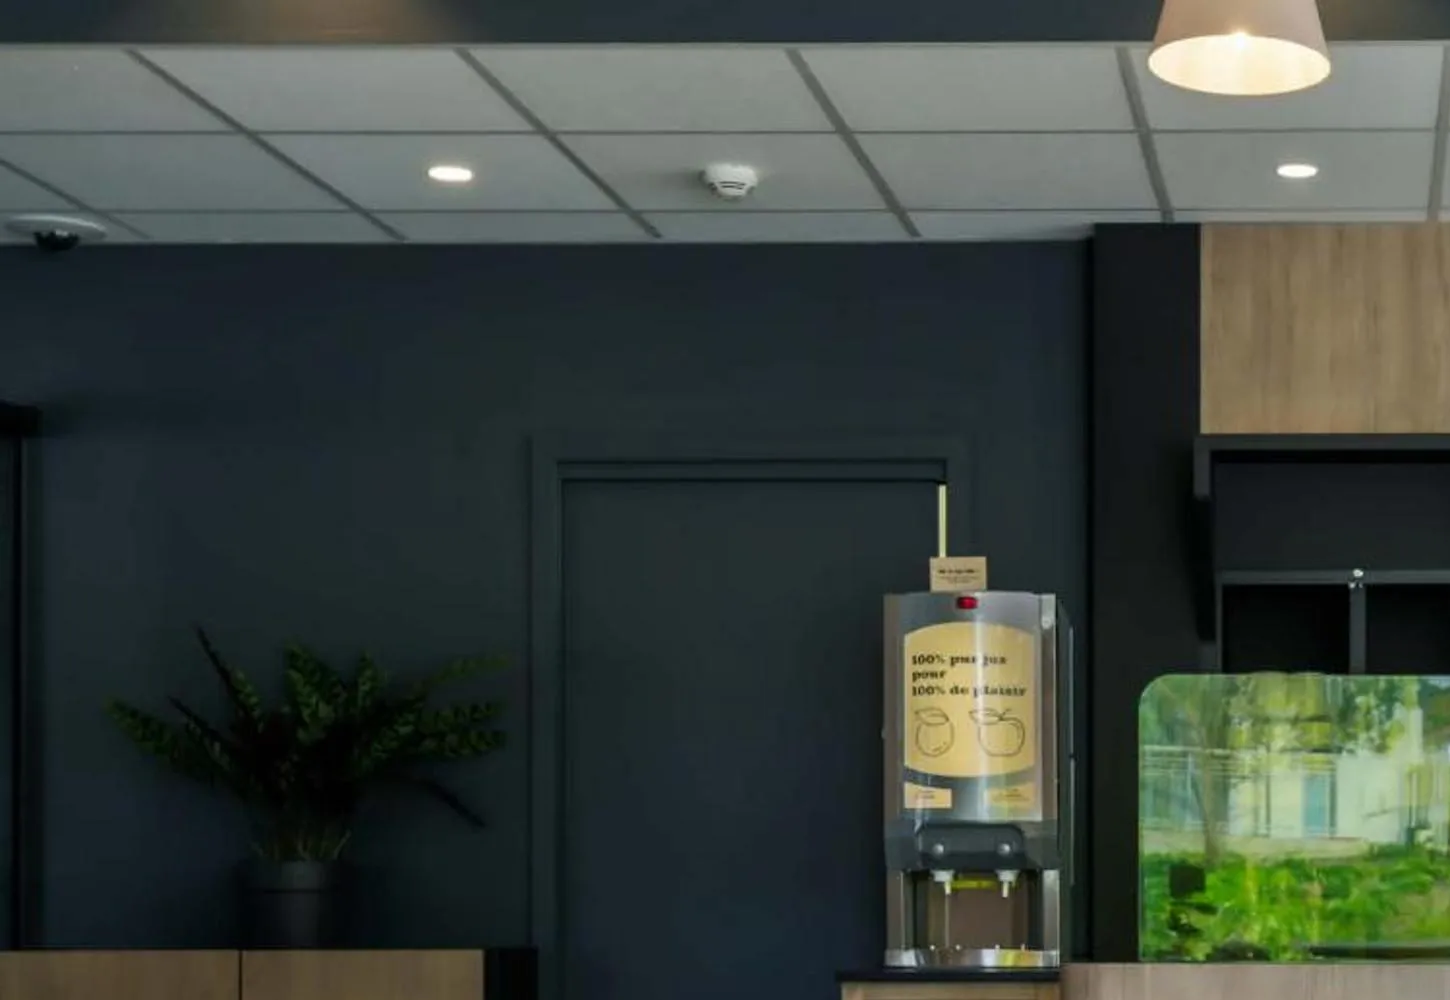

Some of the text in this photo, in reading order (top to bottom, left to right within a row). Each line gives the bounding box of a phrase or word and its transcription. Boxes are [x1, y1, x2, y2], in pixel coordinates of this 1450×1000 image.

[912, 654, 945, 665] 100%
[912, 670, 946, 682] pour
[912, 685, 945, 697] 100%
[949, 685, 970, 696] de
